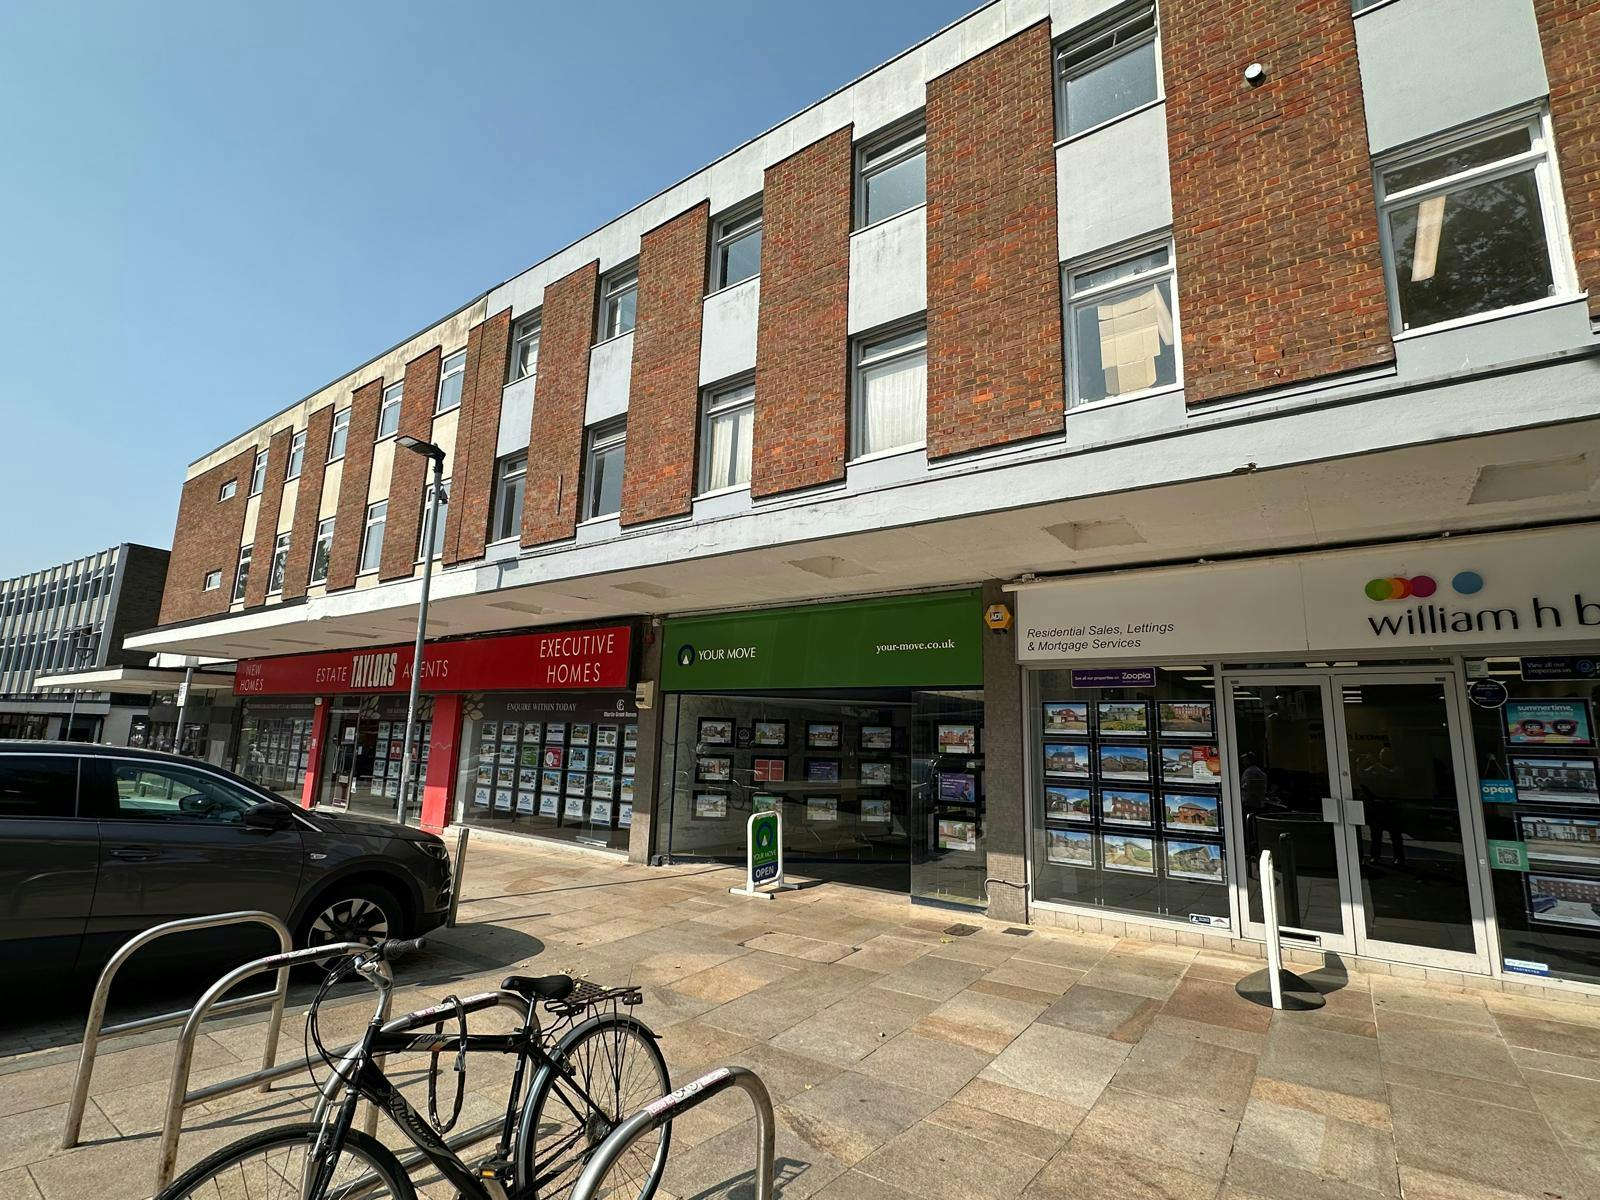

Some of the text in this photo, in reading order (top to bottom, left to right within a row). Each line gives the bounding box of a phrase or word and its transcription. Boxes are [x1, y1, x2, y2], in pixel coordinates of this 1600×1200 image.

[1368, 605, 1519, 636] william
[1532, 597, 1562, 628] h
[1026, 622, 1175, 639] Residential Sales, Lettings
[540, 633, 615, 658] EXECUTIVE
[875, 639, 955, 654] your-move.co.uk
[1027, 638, 1142, 652] & Mortgage Services
[698, 647, 756, 661] YOUR MOVE
[246, 664, 263, 677] NEW
[316, 667, 348, 683] ESTATE
[350, 652, 398, 688] TAYLORS
[546, 662, 601, 683] HOMES
[1122, 672, 1151, 680] Zoopla
[240, 678, 264, 691] HOMES
[506, 703, 577, 712] ENQUIRE WITHIN TODAY
[1482, 786, 1513, 795] open
[755, 865, 775, 878] OPEN
